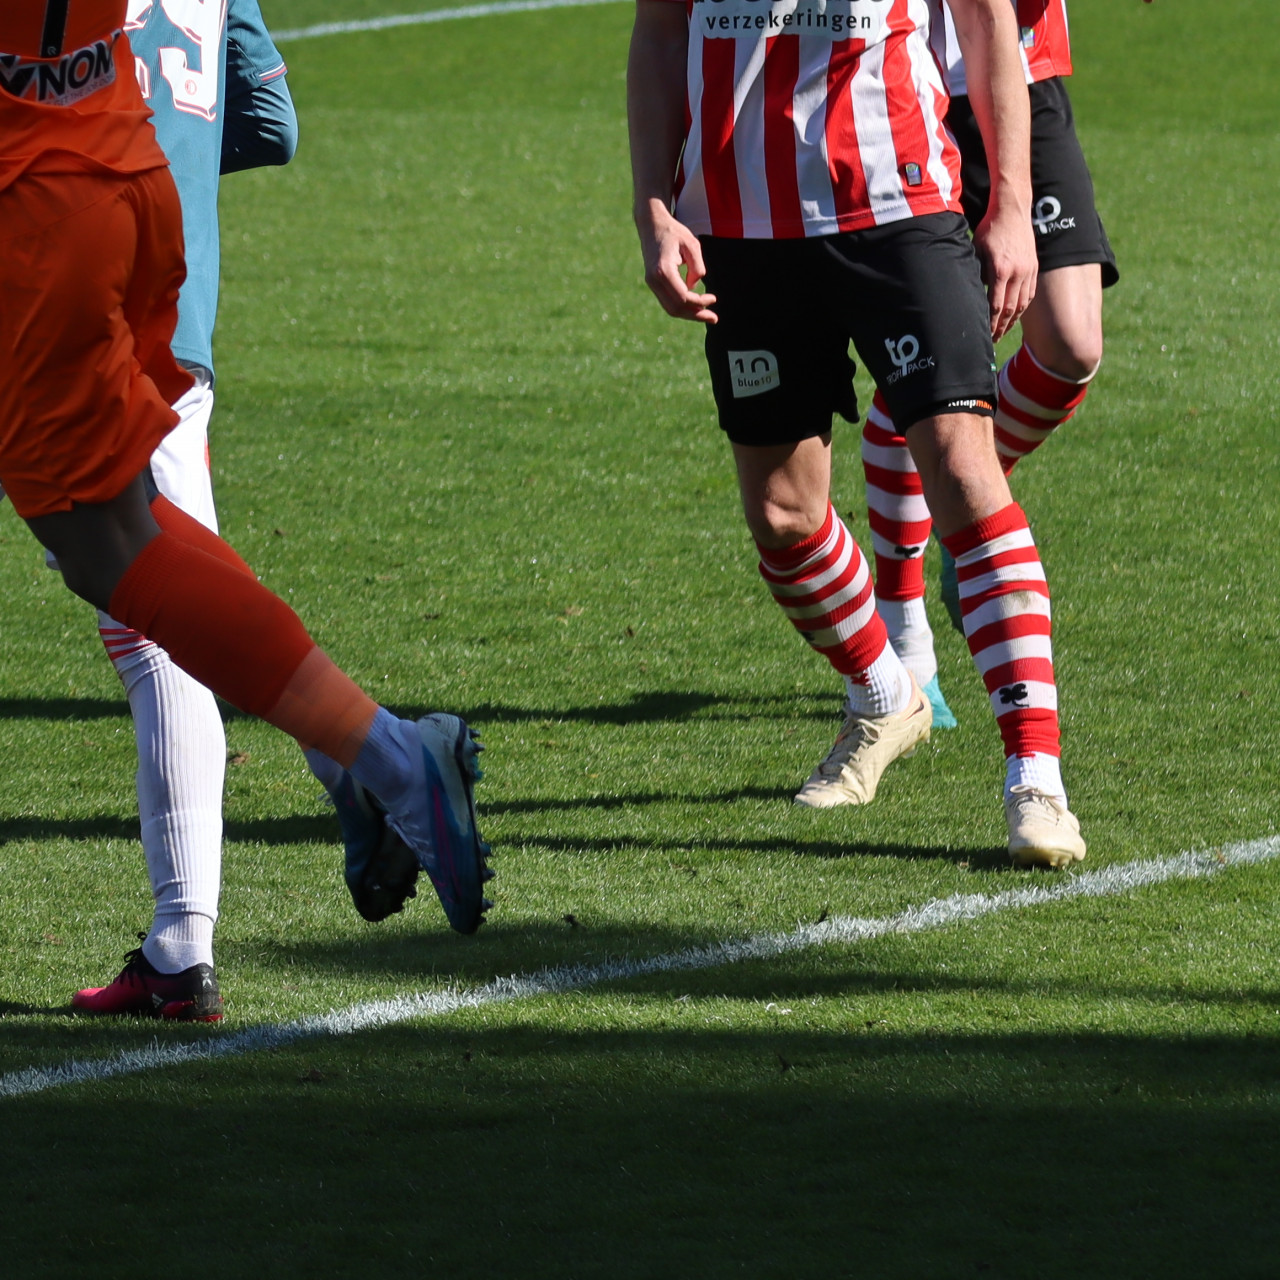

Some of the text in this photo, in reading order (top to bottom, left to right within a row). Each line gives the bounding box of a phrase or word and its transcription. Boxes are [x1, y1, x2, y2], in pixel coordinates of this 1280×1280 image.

[705, 8, 872, 33] verzekeringen
[908, 355, 936, 372] PACK
[737, 376, 772, 388] blue10
